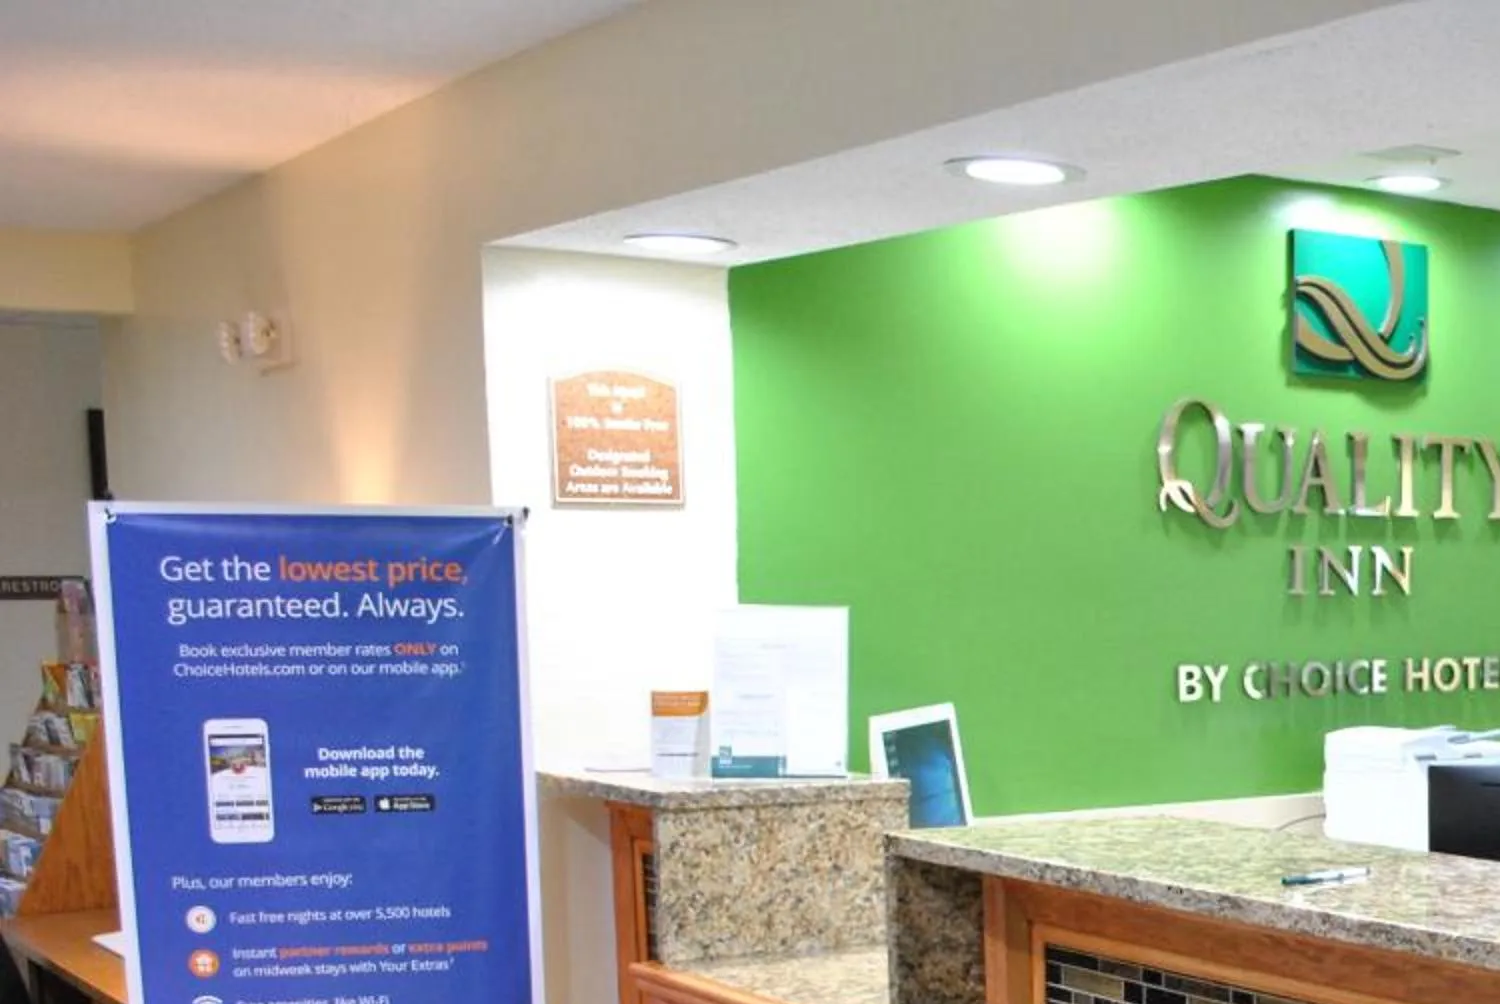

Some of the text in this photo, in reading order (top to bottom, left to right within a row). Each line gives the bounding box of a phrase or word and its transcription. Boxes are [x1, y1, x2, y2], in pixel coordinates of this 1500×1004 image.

[160, 555, 468, 588] Get the lowest price,
[1288, 545, 1414, 597] INN
[1, 581, 60, 593] RESTRO
[167, 592, 465, 626] guaranteed. Always.
[179, 642, 459, 657] Book exclusive member rates ONLY on
[173, 662, 305, 677] ChoiceHotels.com
[308, 664, 325, 676] or
[328, 664, 347, 676] on
[351, 664, 375, 675] our
[379, 661, 428, 675] mobile
[1177, 663, 1229, 703] BY
[1243, 659, 1387, 699] CHOICE
[318, 745, 426, 761] Download the
[304, 762, 441, 780] mobile app today.
[172, 873, 353, 890] Plus, our members enjoy:
[229, 905, 450, 925] Fast free nights at over 5,500 hotels
[233, 946, 276, 960] Instant
[233, 966, 250, 978] on
[253, 963, 313, 977] midweek
[314, 962, 347, 977] stays
[350, 960, 376, 973] with
[379, 959, 408, 972] Your
